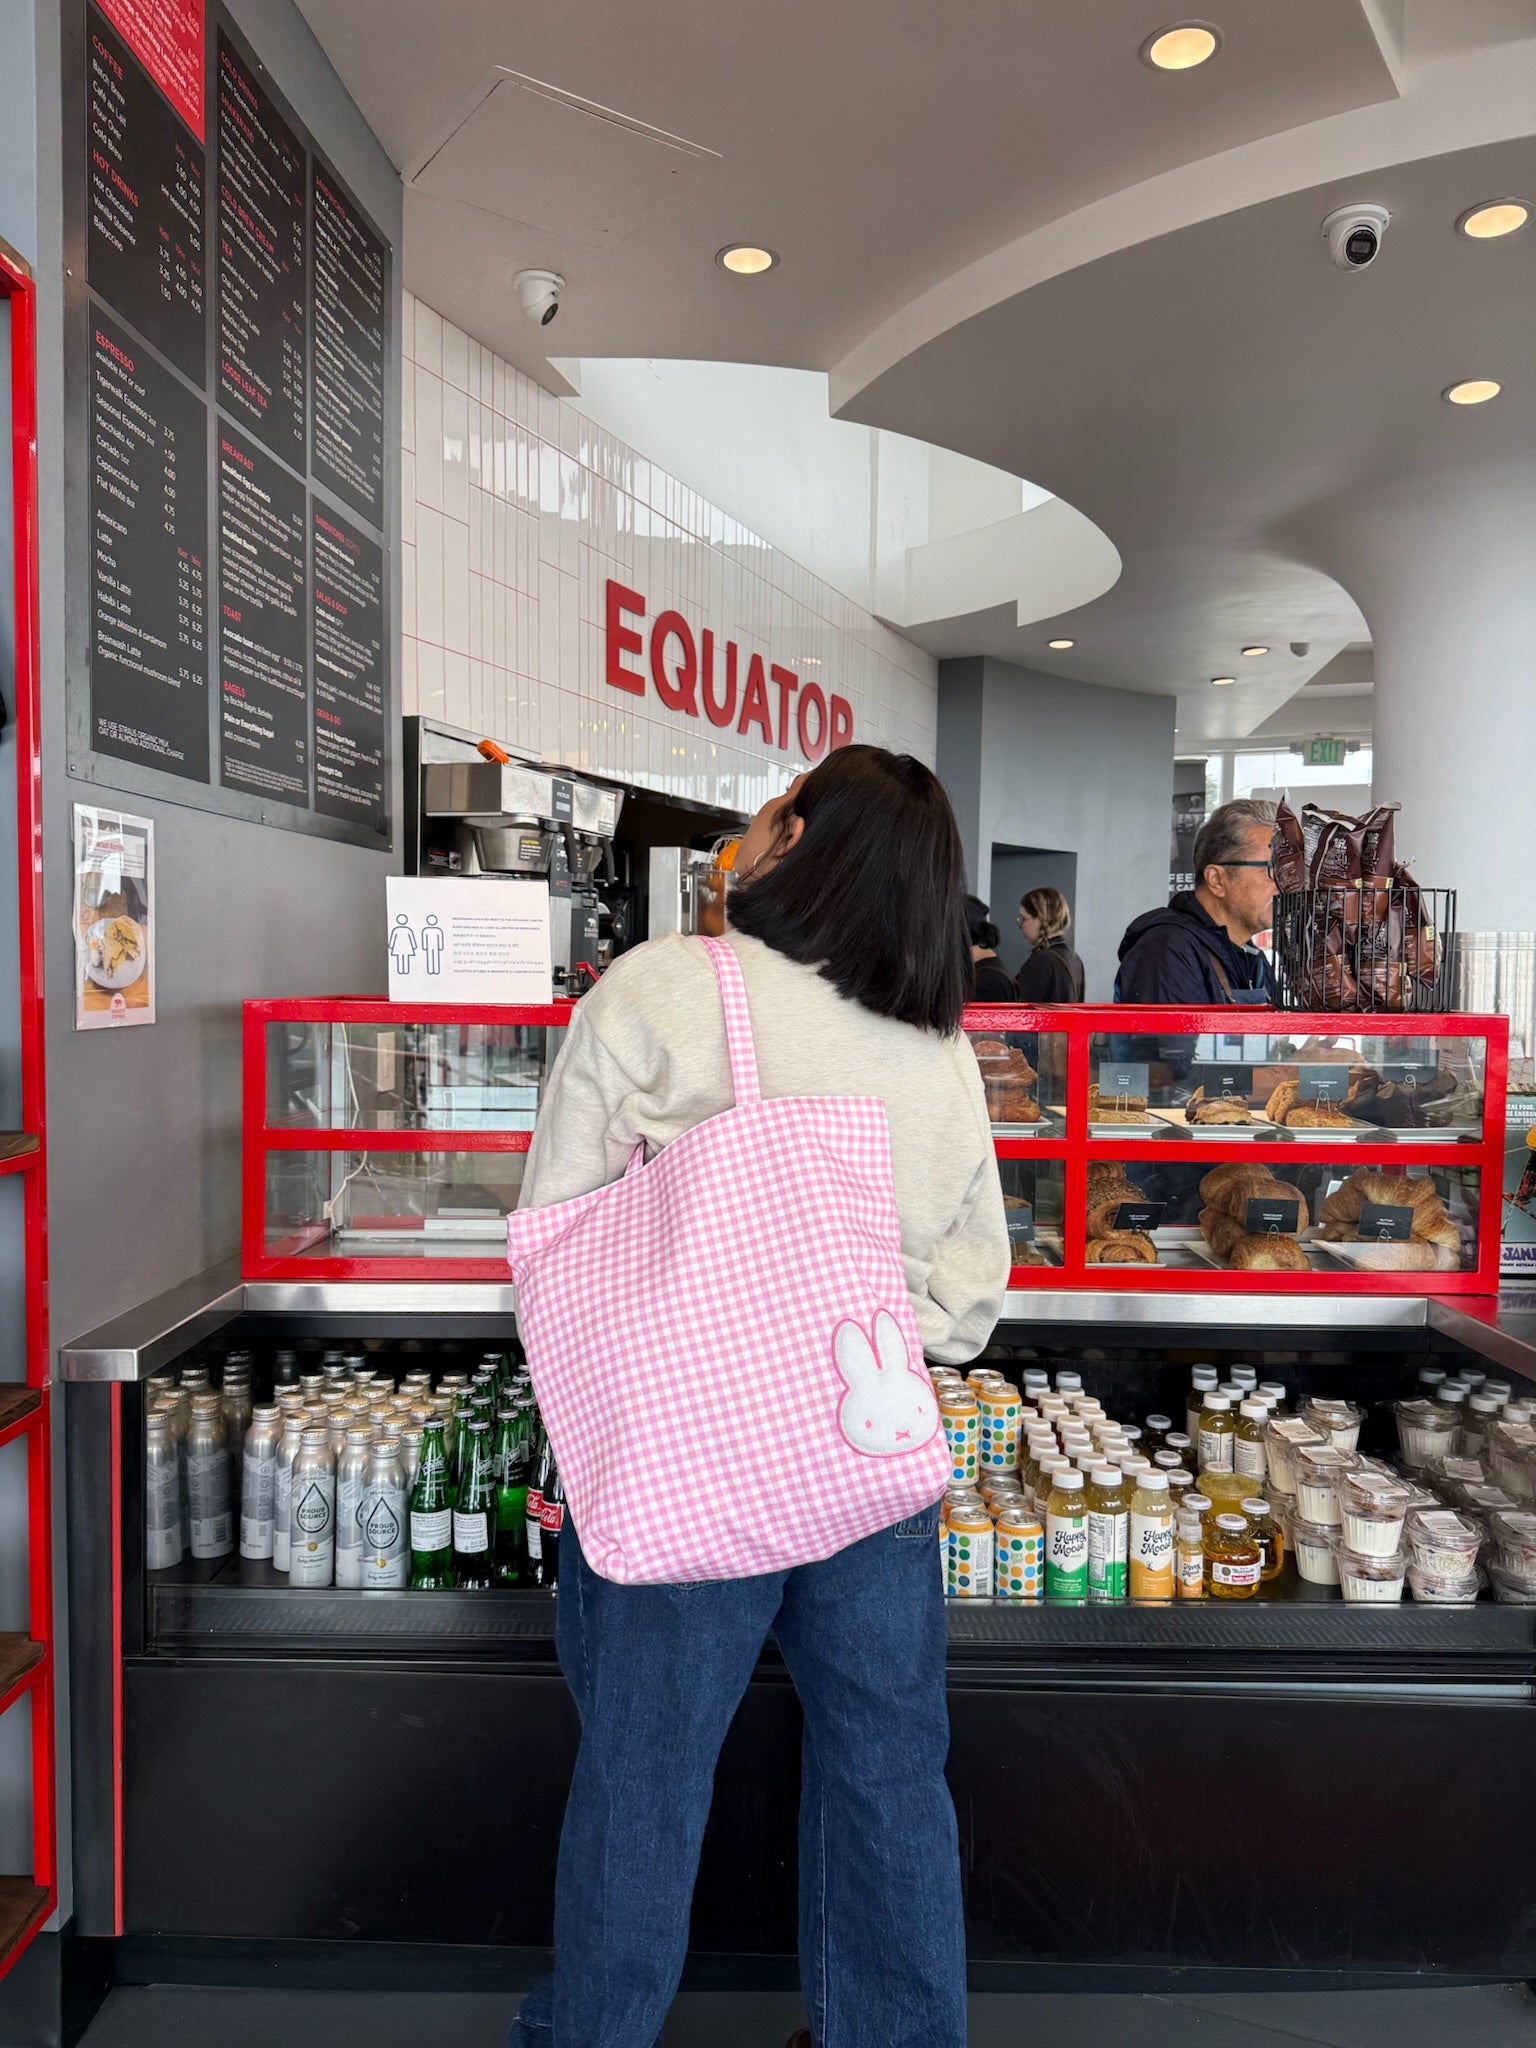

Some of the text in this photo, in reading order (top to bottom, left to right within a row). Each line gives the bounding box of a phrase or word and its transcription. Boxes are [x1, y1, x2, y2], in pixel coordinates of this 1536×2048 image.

[92, 35, 122, 79] COFFEE
[135, 12, 186, 87] Sparkling Lemonade
[221, 51, 237, 78] COLD
[92, 58, 125, 104] Batch Brew
[92, 80, 126, 127] Café au Lait
[92, 100, 121, 140] Pour Over
[93, 122, 122, 161] Cold Brew
[93, 149, 138, 206] HOT DRINKS
[93, 173, 133, 223] Hot Chocolate
[93, 194, 136, 245] Vanilla Steamer
[221, 185, 274, 252] COLD BREW CREAM
[93, 215, 123, 251] Babyccino
[222, 239, 232, 256] TEA
[231, 284, 243, 301] Latte
[237, 324, 248, 340] Latte
[96, 331, 134, 371] ESPRESSO
[95, 351, 145, 396] available hot or iced
[222, 361, 267, 407] LOOSE LEAF TEA
[96, 370, 123, 399] Tigerwalk
[124, 393, 147, 419] Espresso
[96, 393, 121, 420] Seasonal
[122, 414, 146, 439] Espresso
[96, 414, 124, 442] Macchiato
[96, 434, 119, 458] Cortado
[222, 440, 253, 469] BREAKFAST
[96, 455, 129, 484] Cappuccino
[222, 461, 242, 481] Breakfast
[251, 483, 270, 503] Sandwich
[96, 475, 108, 490] Flat
[109, 483, 126, 502] White
[97, 510, 127, 535] Americano
[316, 515, 344, 541] SANDWICHES
[97, 529, 112, 546] Latte
[222, 526, 257, 554] Breakfast Burrito
[97, 549, 116, 567] Mocha
[178, 560, 202, 581] 4.25 4.75
[97, 569, 131, 596] Vanilla Latte
[178, 578, 202, 598] 5.25 5.75
[97, 590, 131, 615] Habibi Latte
[178, 595, 202, 616] 5.75 6.25
[223, 605, 241, 621] TOAST
[316, 589, 347, 614] SALAD SOUP
[97, 609, 167, 649] Orange blossom & cardamom
[178, 613, 202, 633] 5.75 6.25
[223, 627, 242, 642] Avocado
[97, 630, 141, 658] Brainwash Latte
[178, 631, 202, 651] 5.75 6.25
[97, 645, 180, 688] Organic functional mushroom blend
[178, 667, 203, 685] 5.75 6.25
[224, 681, 245, 697] BAGELS
[224, 713, 235, 723] Plain
[240, 719, 262, 733] Everything
[262, 728, 274, 738] bagel
[316, 708, 341, 725] GRAB GO
[98, 718, 107, 727] WE
[107, 721, 118, 731] USE
[137, 731, 158, 744] ORGANIC
[159, 738, 169, 747] MILK
[98, 726, 184, 760] OAT OR ALMOND ADDITIONAL CHARGE
[1310, 741, 1341, 763] EXIT
[299, 1512, 327, 1520] SOURCE
[301, 1506, 325, 1514] PROUD
[369, 1528, 396, 1536] SOURCE
[370, 1522, 395, 1530] PROUD
[1055, 1529, 1086, 1545] Happy
[1143, 1527, 1172, 1544] Happy
[1053, 1542, 1084, 1557] Moose
